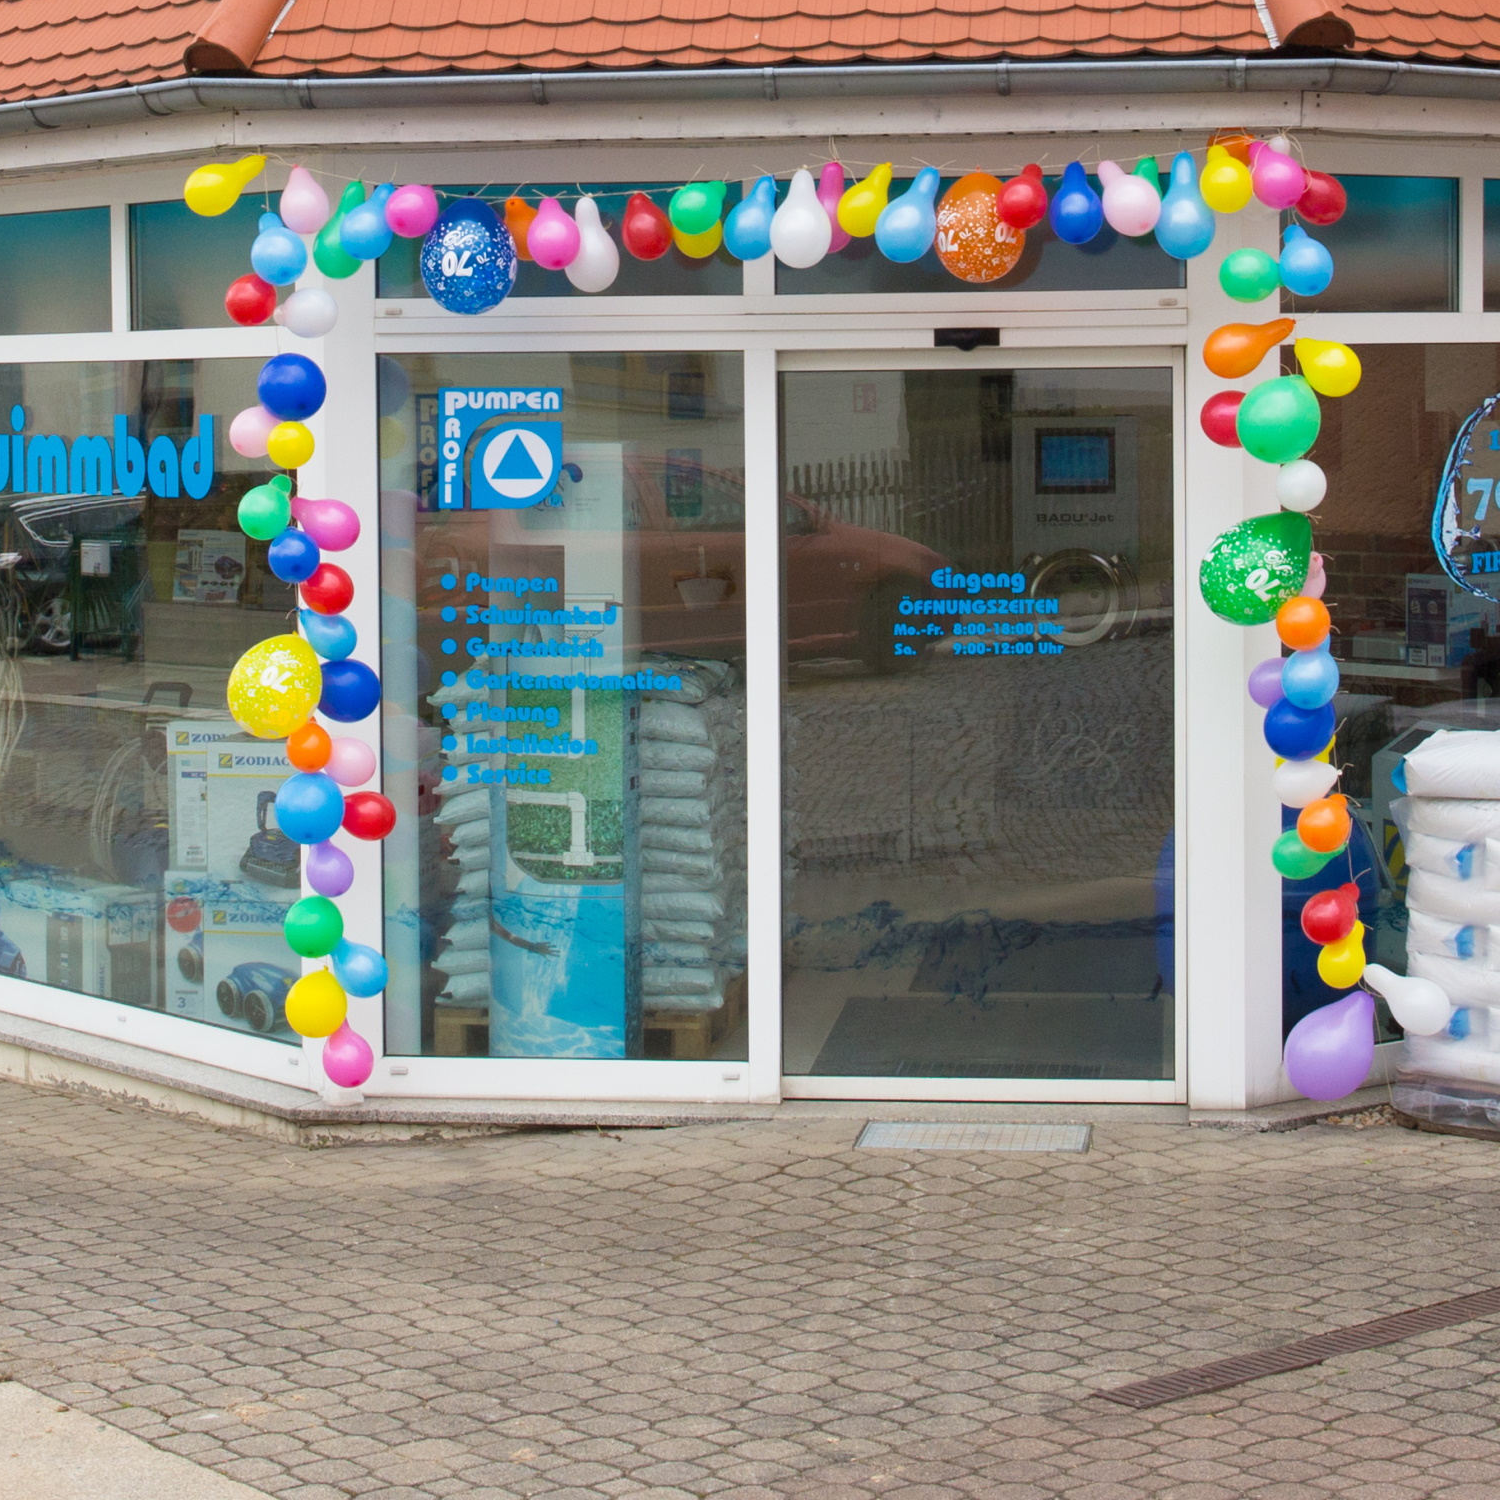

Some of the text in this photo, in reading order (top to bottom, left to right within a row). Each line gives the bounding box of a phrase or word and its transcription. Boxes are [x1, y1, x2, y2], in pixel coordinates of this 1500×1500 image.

[445, 391, 559, 416] PUMPEN
[465, 572, 559, 597] Pumpen
[930, 566, 1026, 594] Eingang
[465, 603, 617, 625] Schwimmbad
[898, 595, 1059, 615] ÖFFNUNGSZEITEN
[893, 622, 1065, 636] Mo.-Fr. 8:00-18:00 Uhr
[465, 635, 604, 658] Gartenteich
[894, 642, 1065, 656] Sa. 9:00-12:00 Uhr
[465, 668, 683, 690] Gartenautomation
[466, 701, 560, 728] Planung
[466, 732, 598, 755] Installation
[467, 762, 552, 785] Service
